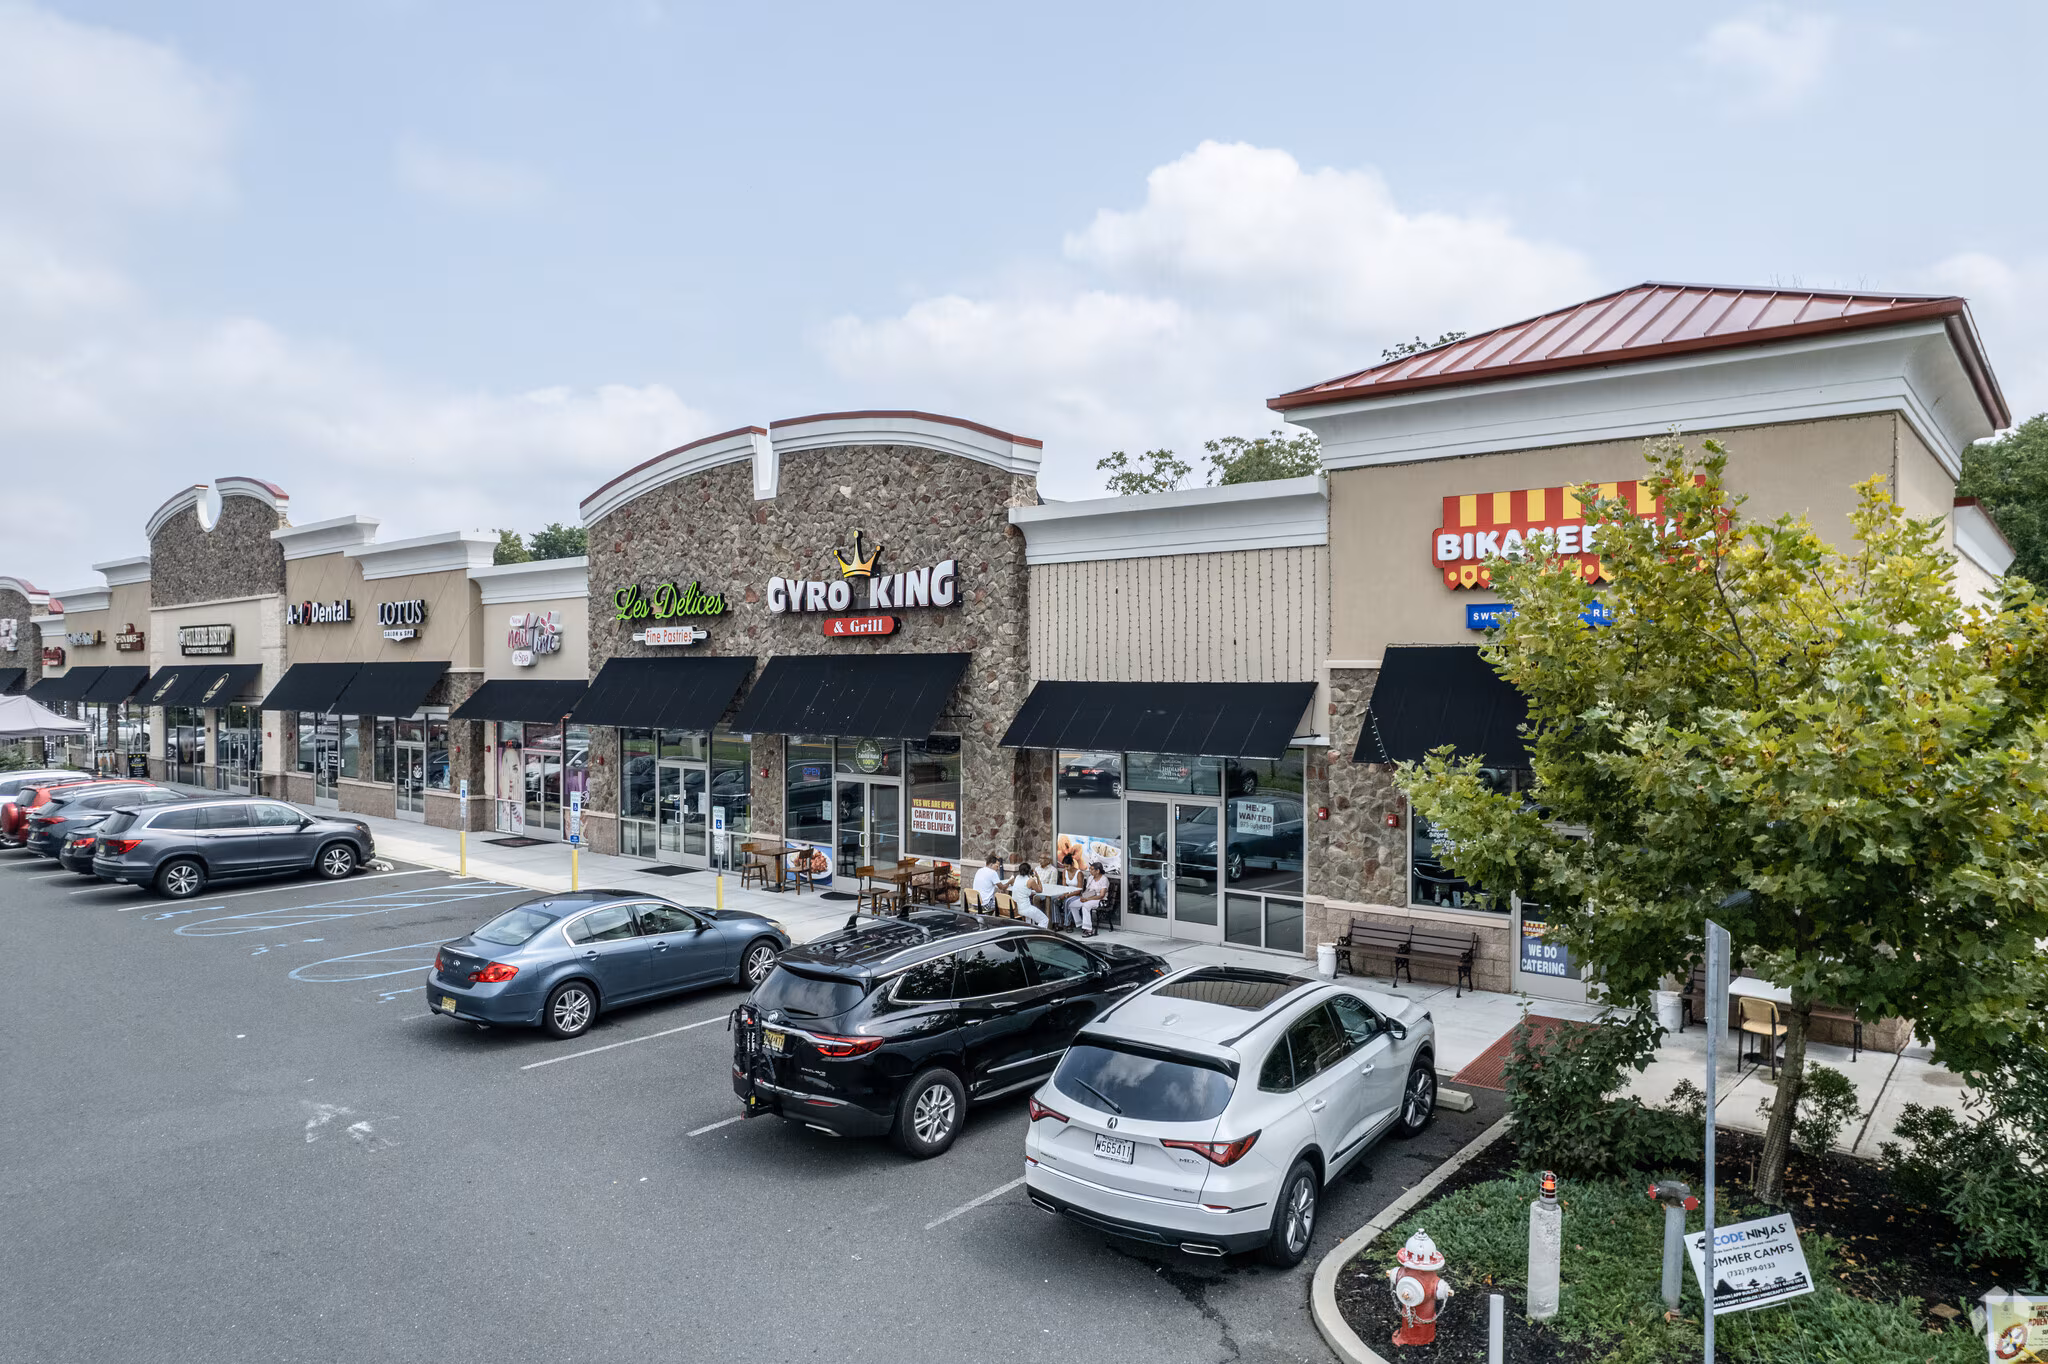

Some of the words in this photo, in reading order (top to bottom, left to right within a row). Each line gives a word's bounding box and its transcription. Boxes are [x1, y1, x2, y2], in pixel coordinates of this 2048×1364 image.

[767, 576, 851, 613] GYRO
[869, 559, 955, 608] KING
[614, 584, 650, 620] Les
[654, 580, 725, 619] Délices
[311, 600, 348, 622] Dental
[377, 600, 422, 626] LOTUS
[1473, 611, 1520, 620] SWES
[507, 612, 531, 649] nail
[833, 621, 845, 634] &
[850, 618, 883, 633] Grill
[646, 630, 661, 643] Fine
[663, 628, 692, 643] Pastries
[802, 766, 821, 776] OPEN
[912, 798, 922, 807] YES
[923, 799, 931, 808] WE
[931, 799, 941, 808] ARE
[941, 800, 955, 809] OPEN
[914, 809, 934, 820] CARRY
[934, 810, 947, 821] OUT
[947, 812, 953, 821] &
[1239, 811, 1272, 823] WANTED
[913, 820, 926, 830] FREE
[927, 821, 954, 833] DELIVERY
[1528, 944, 1542, 957] WE
[1544, 945, 1557, 959] DO
[1521, 958, 1565, 975] CATERING
[1714, 1231, 1745, 1246] CODE
[1745, 1223, 1786, 1240] NINJAS
[1703, 1252, 1752, 1268] UMMER
[1754, 1243, 1794, 1259] CAMPS
[1727, 1269, 1745, 1279] (732)
[1746, 1262, 1776, 1274] 759-0133
